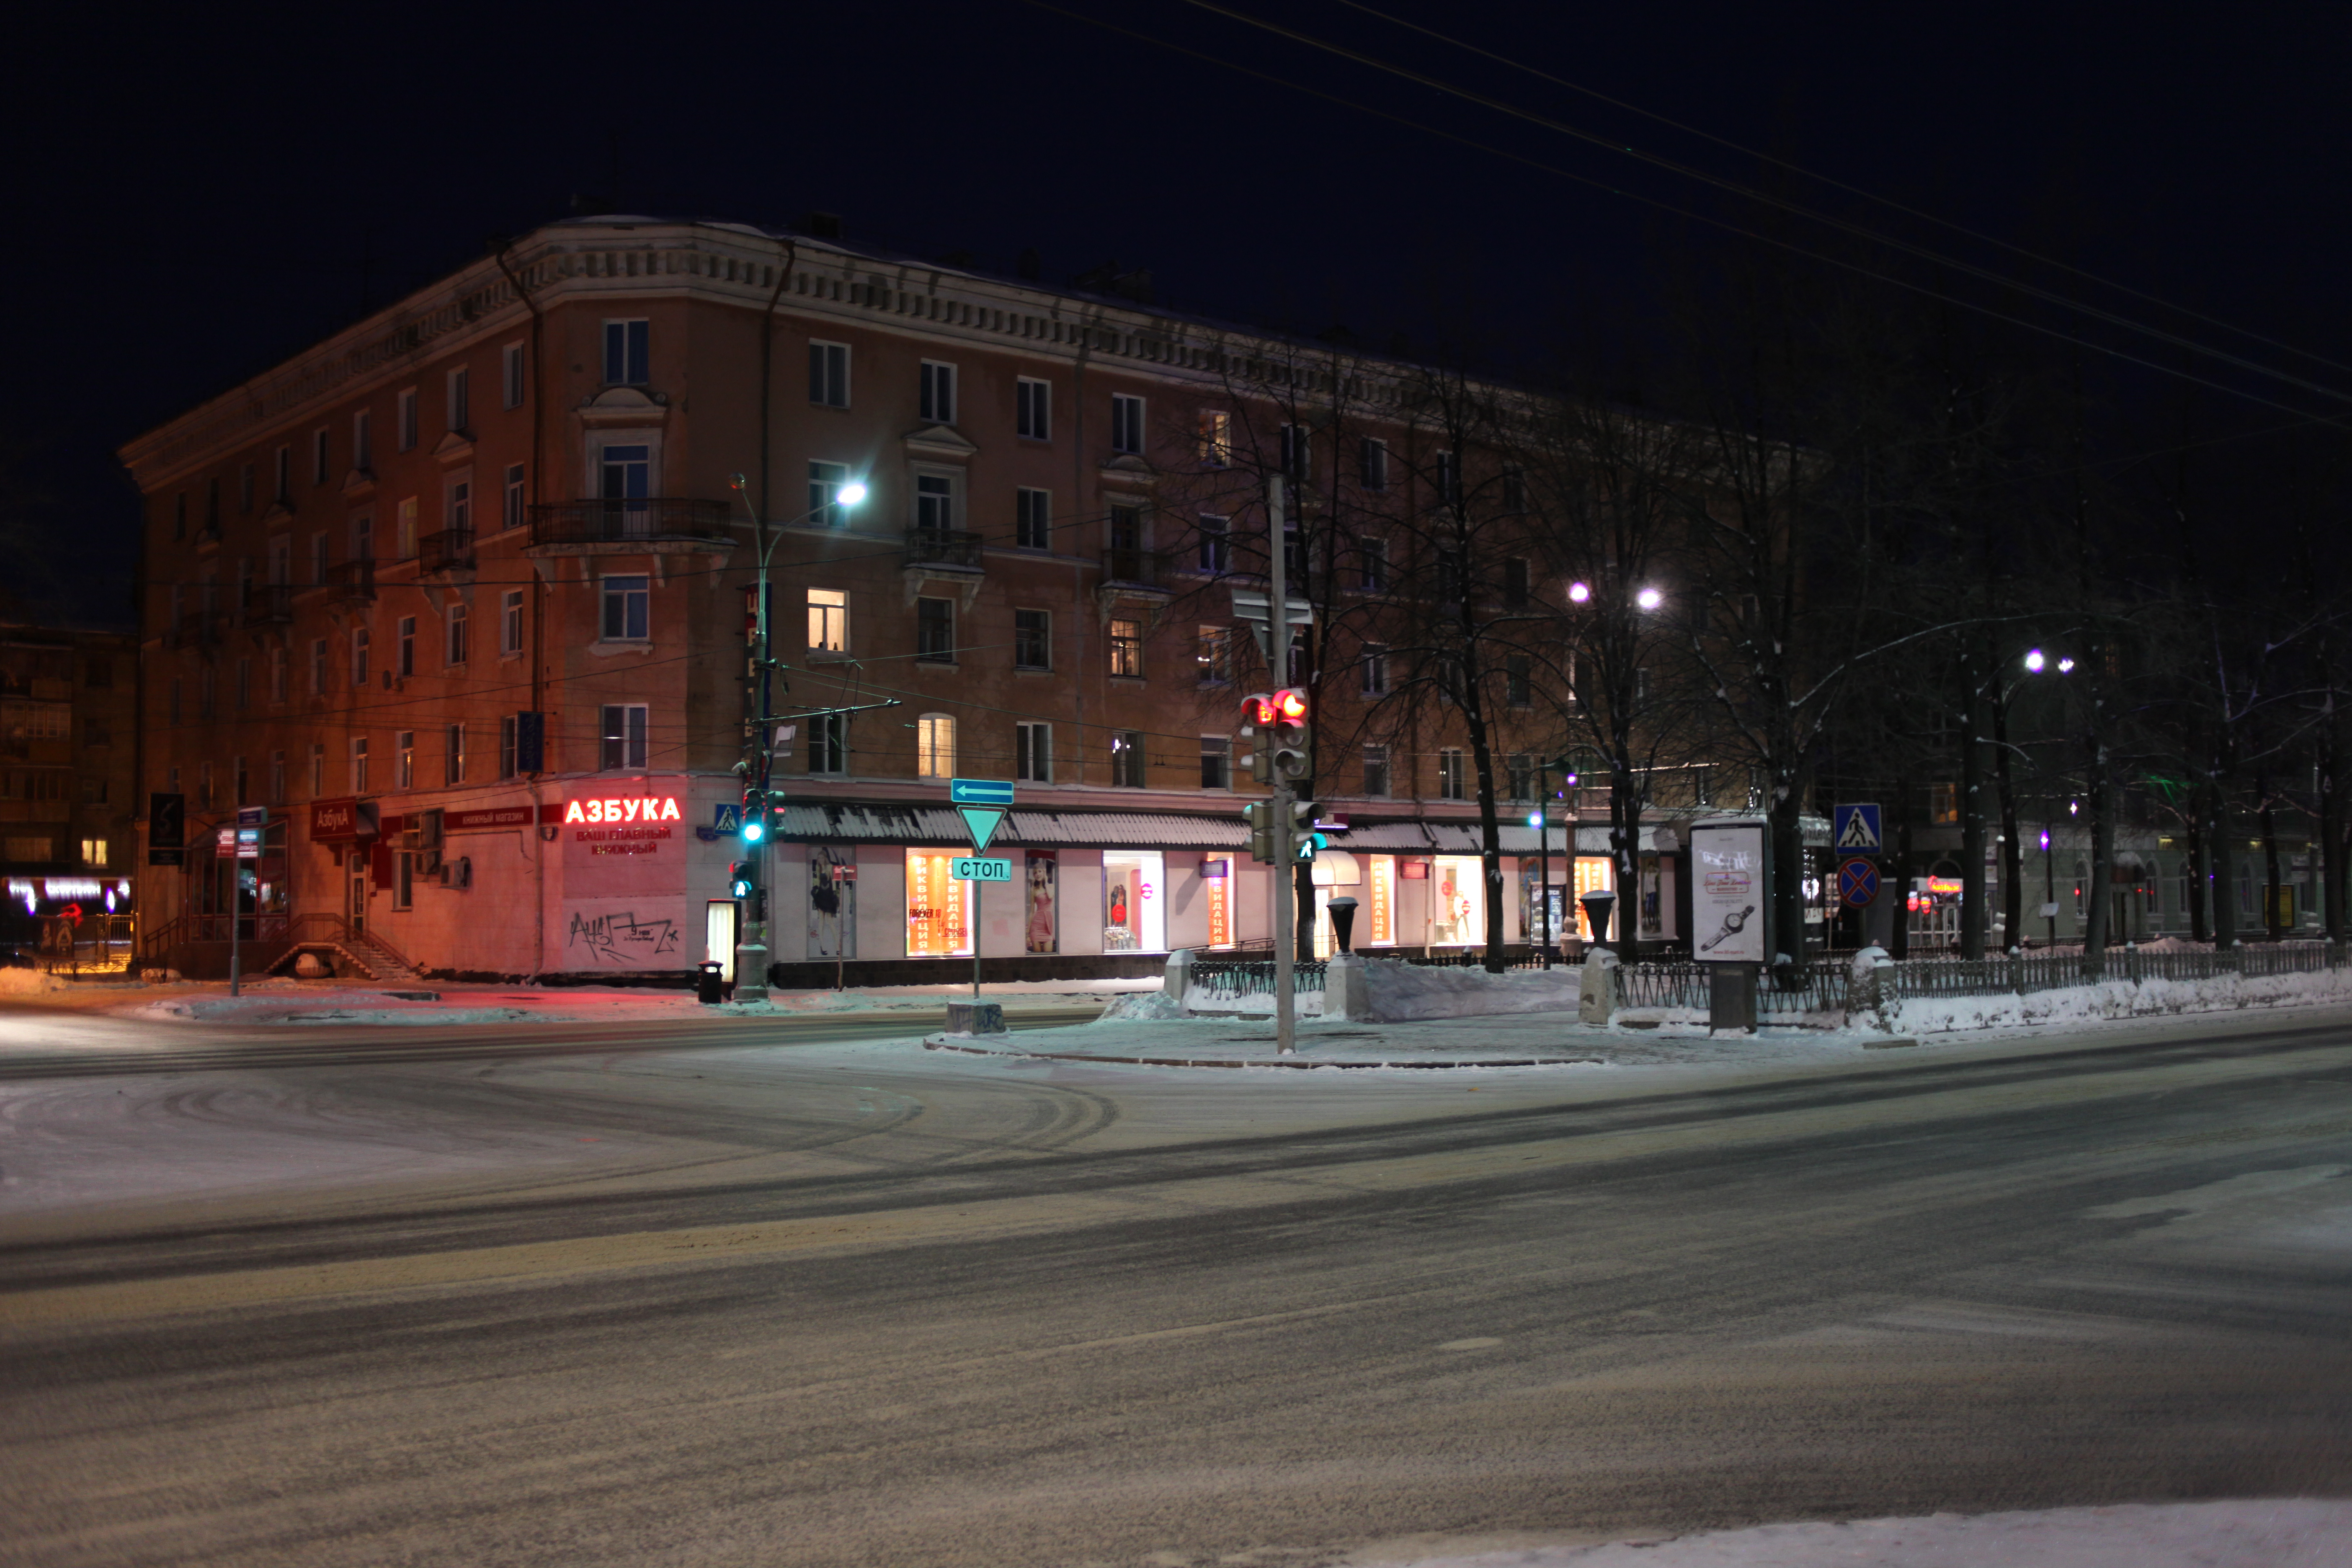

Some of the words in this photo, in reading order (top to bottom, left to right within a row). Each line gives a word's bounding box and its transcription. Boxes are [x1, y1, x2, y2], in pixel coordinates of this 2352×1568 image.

[462, 812, 494, 825] книжный
[495, 812, 524, 822] магазин
[565, 798, 681, 823] АЗБУКА
[577, 831, 605, 841] ВАШ
[609, 826, 671, 841] ГЛАВНЫЙ
[591, 841, 657, 855] КНИЖНЫЙ
[961, 861, 1003, 877] СТОП
[916, 858, 928, 949] ЛИКВИДАЦИЯ
[947, 858, 959, 948] КВИДАЦИЯ
[1213, 877, 1223, 942] КВИДАЦИЯ
[1374, 862, 1384, 939] ЛИКВИДАЦИЯ
